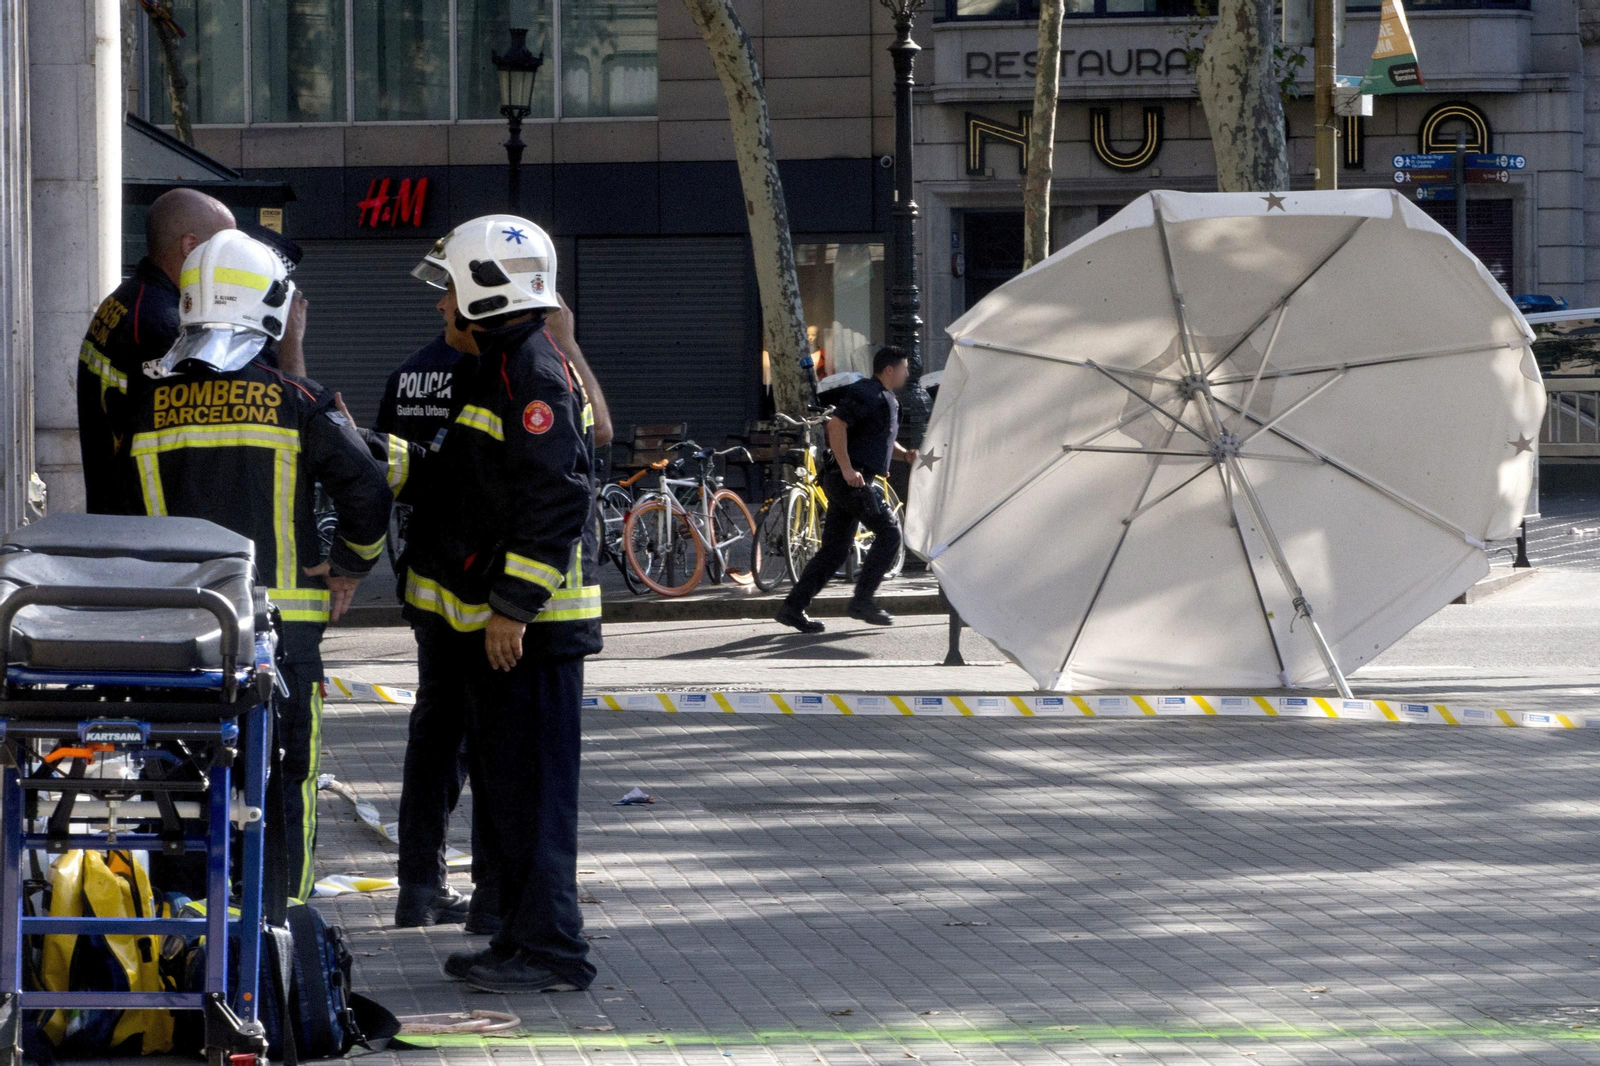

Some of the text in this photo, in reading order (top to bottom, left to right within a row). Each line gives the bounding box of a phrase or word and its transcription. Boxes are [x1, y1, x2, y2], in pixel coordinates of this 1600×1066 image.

[966, 48, 1200, 79] RESTAURA
[357, 177, 428, 228] H&M
[153, 379, 283, 412] BOMBERS
[153, 404, 279, 430] BARCELONA
[86, 732, 142, 741] KARTSANA
